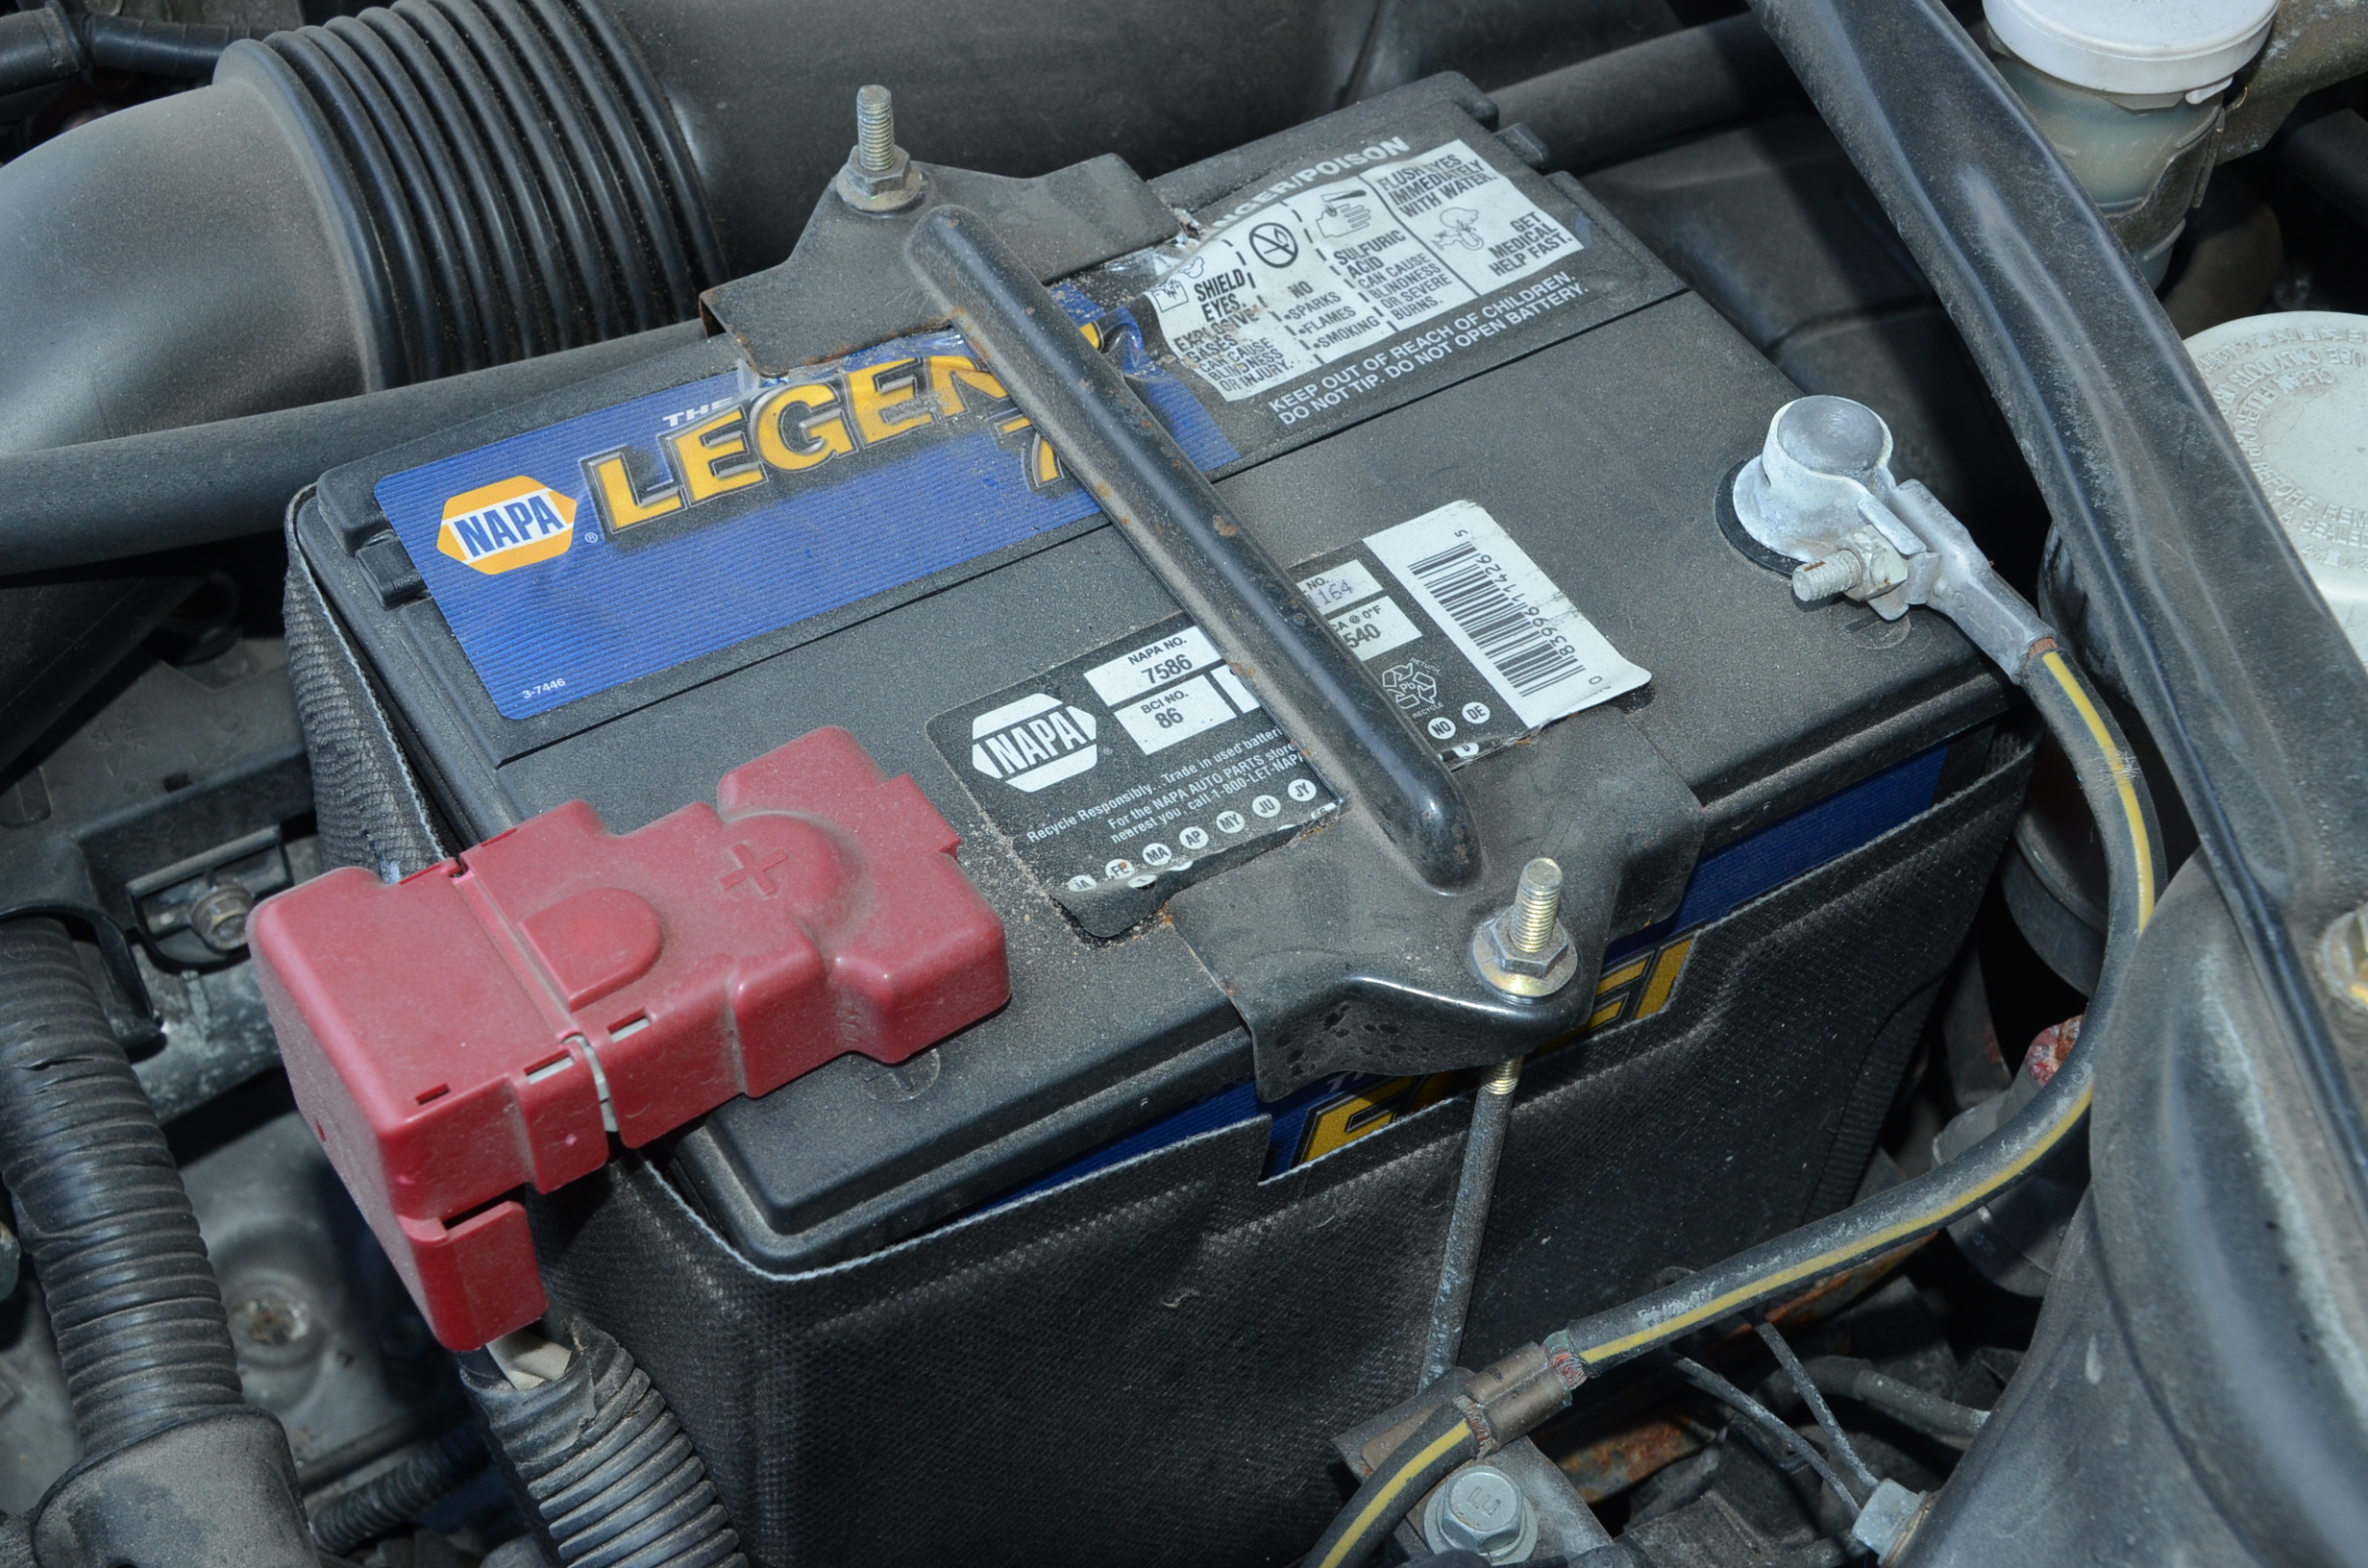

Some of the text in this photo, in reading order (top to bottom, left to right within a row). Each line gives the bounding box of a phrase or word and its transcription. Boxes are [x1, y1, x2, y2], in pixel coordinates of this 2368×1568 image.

[1376, 154, 1462, 191] FLUSH EYES
[1389, 159, 1485, 206] IMMEDIATELY
[1398, 173, 1498, 218] WITH WATER.
[1510, 211, 1543, 233] GET
[1333, 230, 1406, 266] SULFURIC
[1488, 222, 1559, 259] MEDICAL
[1488, 232, 1572, 277] HELP FAST.
[1346, 256, 1385, 279] ACID
[1358, 253, 1431, 290] CAN CAUSE
[1369, 262, 1442, 300] BLINDNESS
[1194, 268, 1246, 303] SHIELD
[1287, 281, 1314, 299] NO
[1380, 273, 1453, 309] OR SEVERE
[1201, 293, 1246, 322] EYES.
[1391, 295, 1443, 321] BURNS.
[1186, 334, 1239, 363] GASES
[1199, 337, 1274, 373] CAN CAUSE
[1269, 271, 1576, 412] KEEP OUT OF REACH OF CHILDREN.
[1278, 282, 1589, 426] DO NOT TIP. DO NOT OPEN BATTERY.
[1208, 348, 1284, 381] BLINDNESS
[2274, 348, 2322, 369] ONLY
[1219, 359, 1295, 392] OR INJURY.
[2273, 367, 2335, 393] CLEAN
[586, 320, 1103, 534] LEGEN
[2251, 461, 2317, 511] BEFORE
[454, 495, 564, 558] NAPA
[1306, 576, 1329, 590] NO.
[1475, 554, 1526, 602] 11426
[1343, 624, 1381, 649] 540
[1523, 606, 1576, 657] 83996
[1127, 636, 1187, 665] NAPA NO.
[1141, 653, 1193, 684] 7586
[522, 677, 566, 699] 3-7446
[1140, 690, 1189, 714] BCI NO.
[1399, 681, 1417, 693] Pb
[1154, 707, 1184, 728] 86
[1412, 701, 1444, 719] RECYCLE
[1466, 705, 1487, 721] DE
[985, 711, 1087, 774] NAPA
[1431, 721, 1452, 736] NO
[1026, 816, 1077, 844] Recycle
[1198, 756, 1213, 770] in
[1213, 744, 1243, 764] used
[1107, 815, 1131, 830] For
[1130, 805, 1152, 820] the
[1152, 788, 1189, 810] NAPA
[1189, 772, 1223, 796] AUTO
[1223, 754, 1265, 779] PARTS
[1258, 797, 1276, 814] JU
[1294, 782, 1310, 797] JY
[1110, 817, 1158, 845] nearest
[1187, 792, 1212, 810] call
[1219, 814, 1241, 831] MY
[1184, 830, 1201, 846] AP
[1145, 845, 1169, 864] MA
